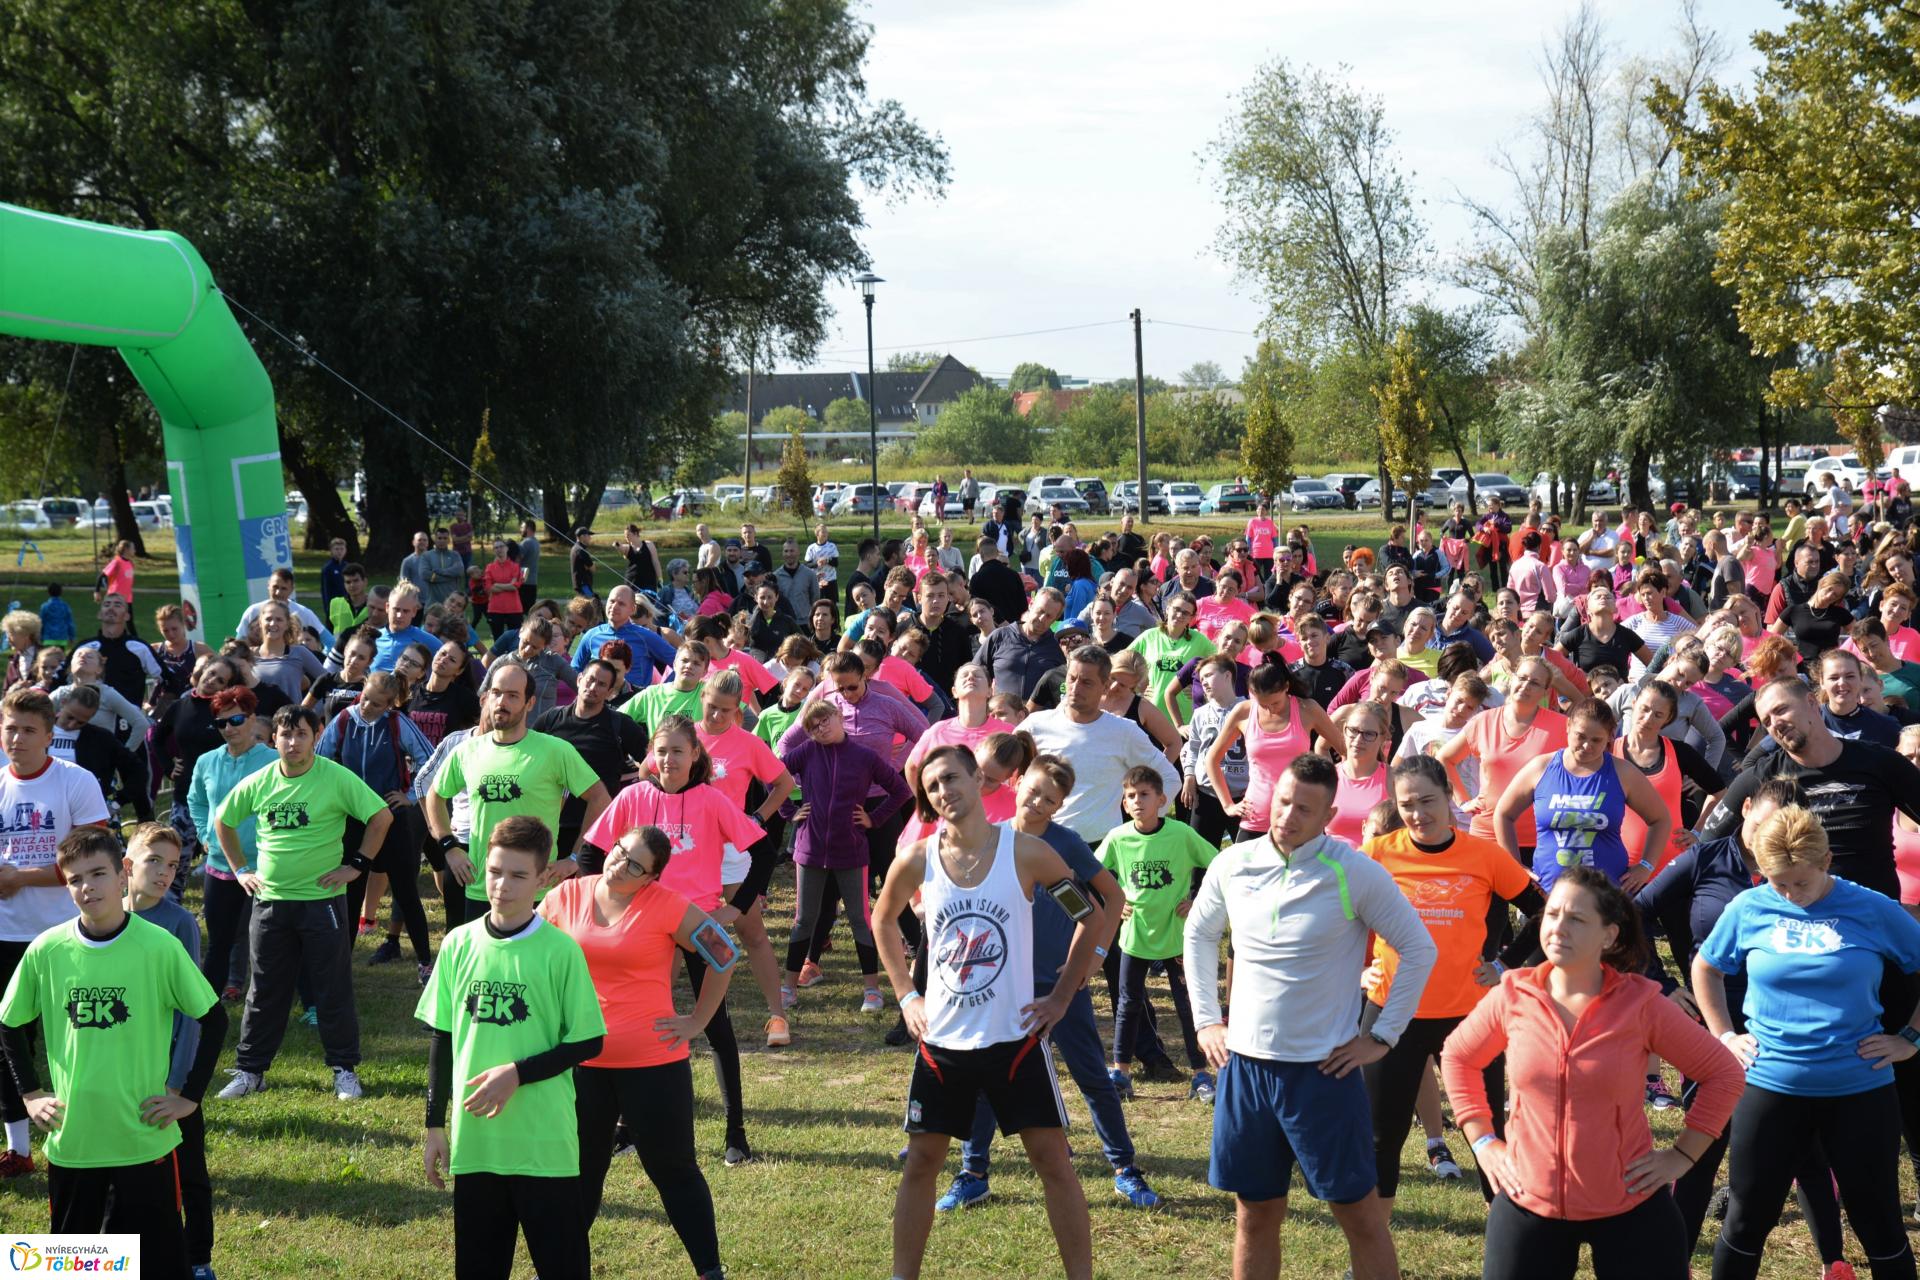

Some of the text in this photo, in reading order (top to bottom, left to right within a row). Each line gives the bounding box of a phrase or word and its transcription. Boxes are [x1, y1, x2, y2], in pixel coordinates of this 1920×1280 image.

[410, 711, 448, 723] SWEAT
[480, 774, 520, 785] CRAZY
[486, 784, 513, 800] 5K
[269, 802, 309, 812] CRAZY
[275, 811, 300, 827] 5K
[11, 837, 36, 845] WIZZ
[38, 835, 57, 843] AIR
[1131, 860, 1170, 871] CRAZY
[1137, 870, 1164, 887] 5K
[976, 898, 1011, 924] ISLAND
[1775, 918, 1840, 932] CRAZY
[1785, 930, 1827, 949] 5K
[68, 986, 127, 1002] CRAZY
[469, 980, 528, 999] CRAZY
[941, 987, 996, 1009] ACH GEAR
[77, 1001, 115, 1024] 5K
[477, 995, 515, 1021] 5K
